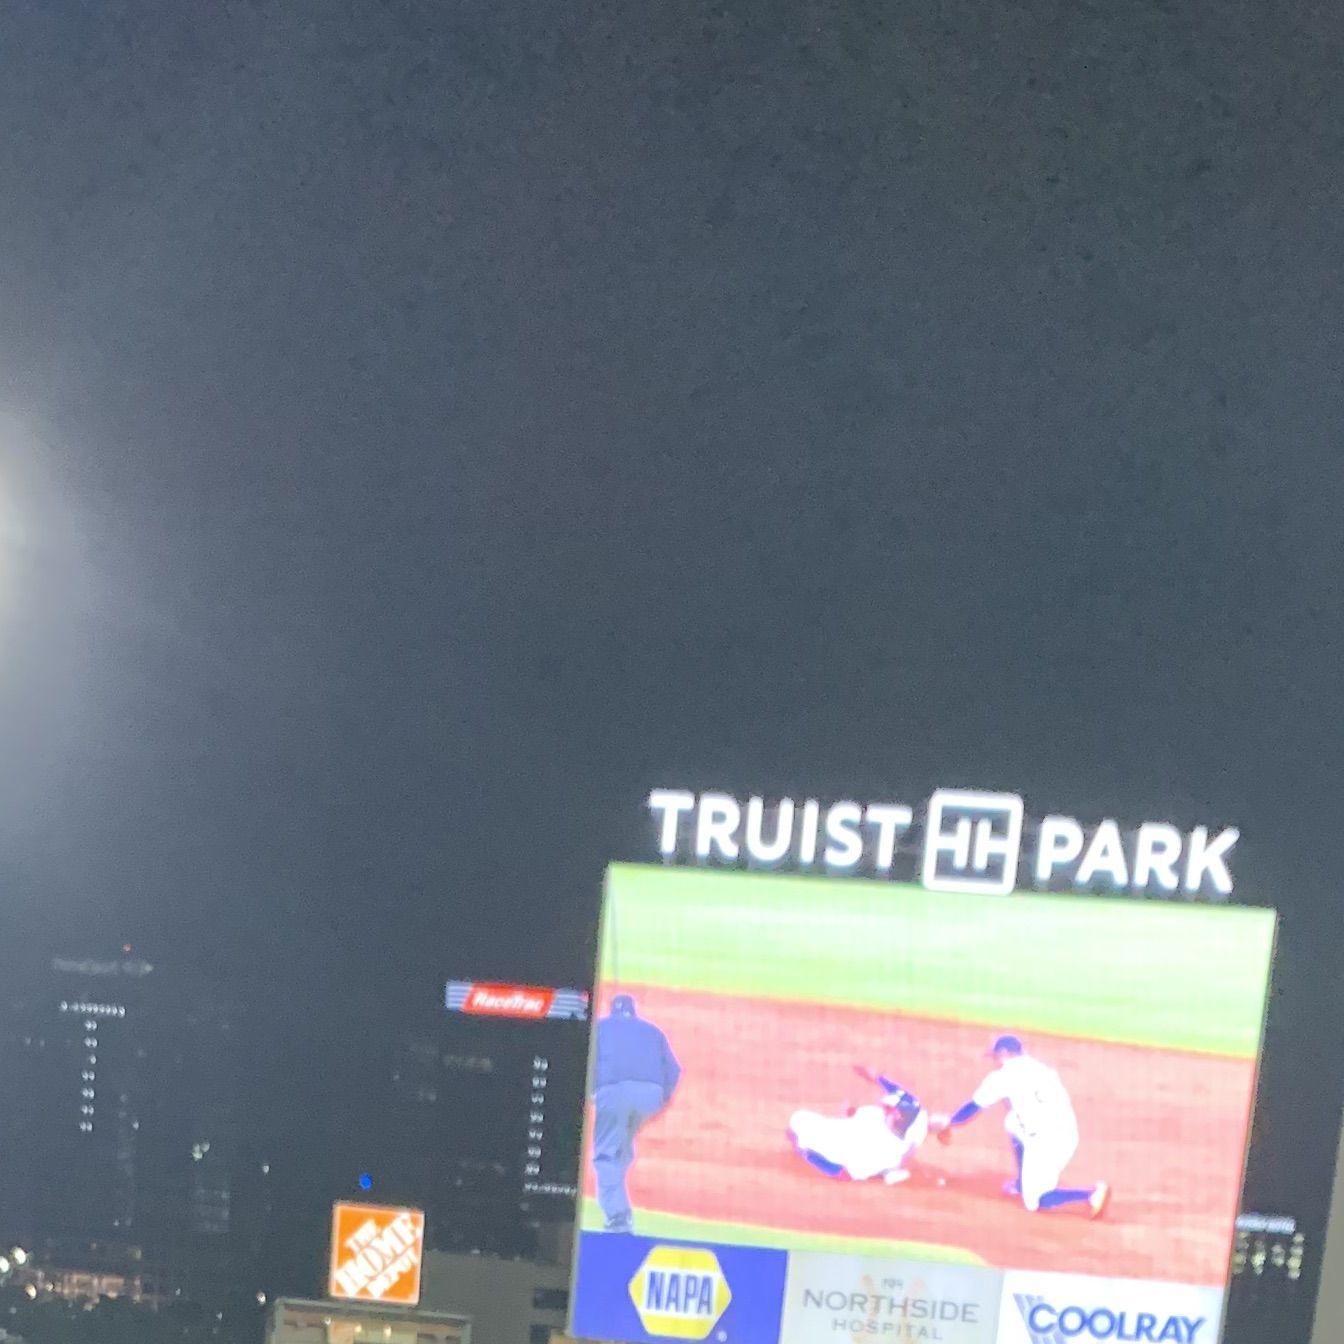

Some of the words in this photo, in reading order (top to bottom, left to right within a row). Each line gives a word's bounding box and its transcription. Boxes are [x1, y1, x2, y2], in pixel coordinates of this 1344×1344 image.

[650, 789, 913, 870] TRUIST
[1036, 814, 1241, 894] PARK
[333, 1210, 421, 1298] HOME
[645, 1270, 716, 1316] NAPA
[802, 1289, 981, 1323] NORTHSIDE
[832, 1319, 944, 1341] HOSPITAL
